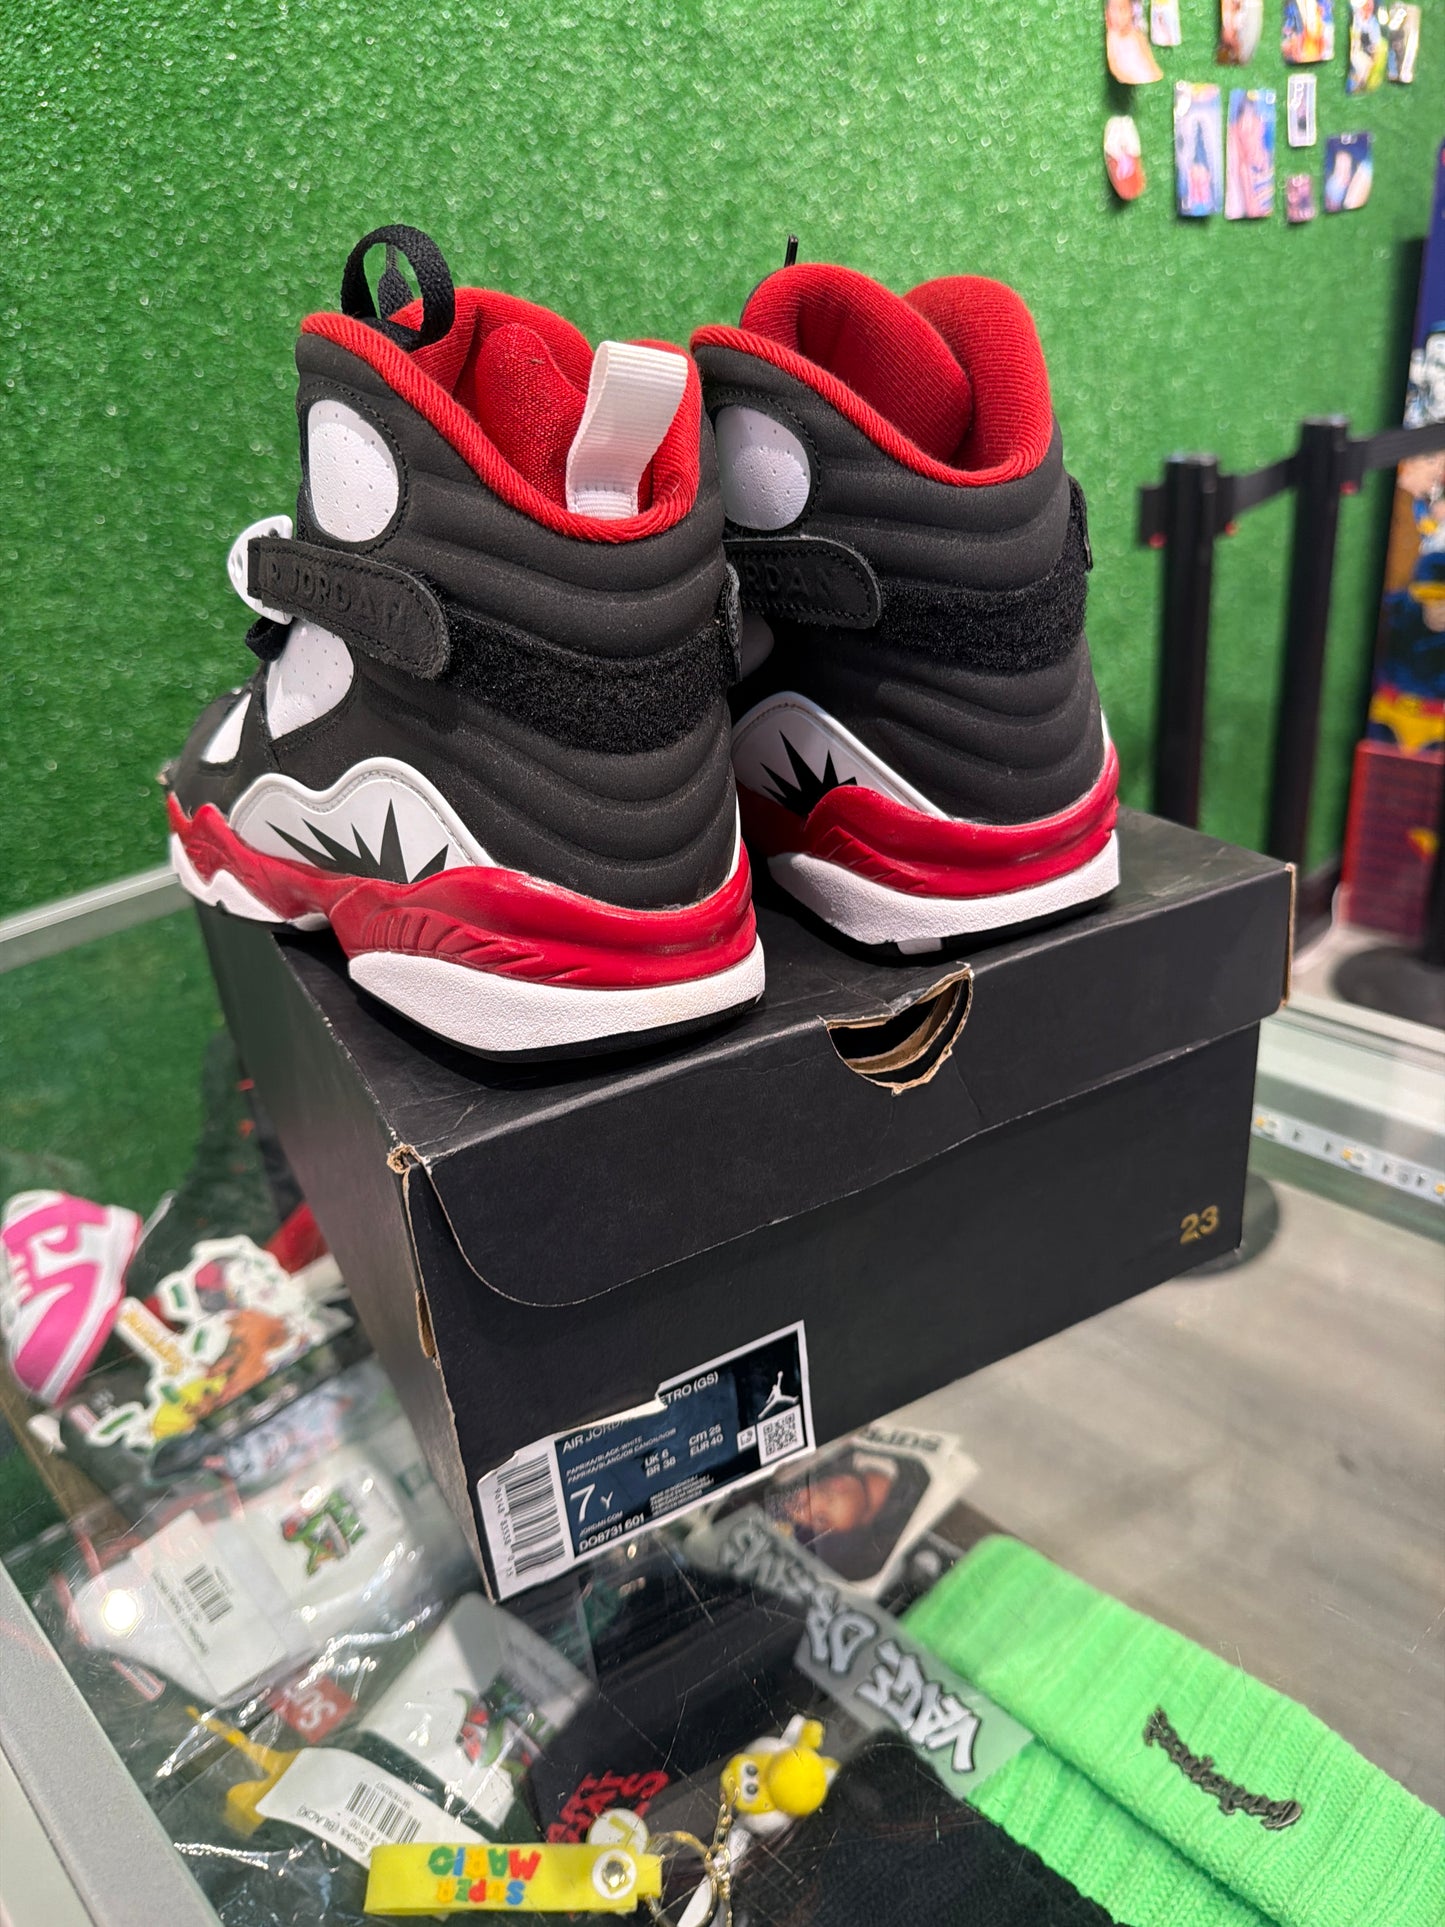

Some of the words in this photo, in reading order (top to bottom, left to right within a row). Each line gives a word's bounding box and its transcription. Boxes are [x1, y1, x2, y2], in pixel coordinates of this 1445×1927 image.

[1180, 1205, 1219, 1245] 23
[562, 1433, 584, 1455] AIR
[693, 1371, 719, 1392] (GS)
[689, 1430, 708, 1447] cm
[709, 1423, 722, 1437] 25
[690, 1440, 710, 1458] EUR
[710, 1433, 724, 1447] 40
[644, 1452, 660, 1468] UK
[661, 1448, 670, 1460] 6
[646, 1463, 661, 1479] BR
[570, 1483, 596, 1524] 7
[600, 1491, 614, 1511] Y
[624, 1512, 645, 1530] 601
[427, 1845, 542, 1881] MARIO
[436, 1878, 526, 1906] SUPER
